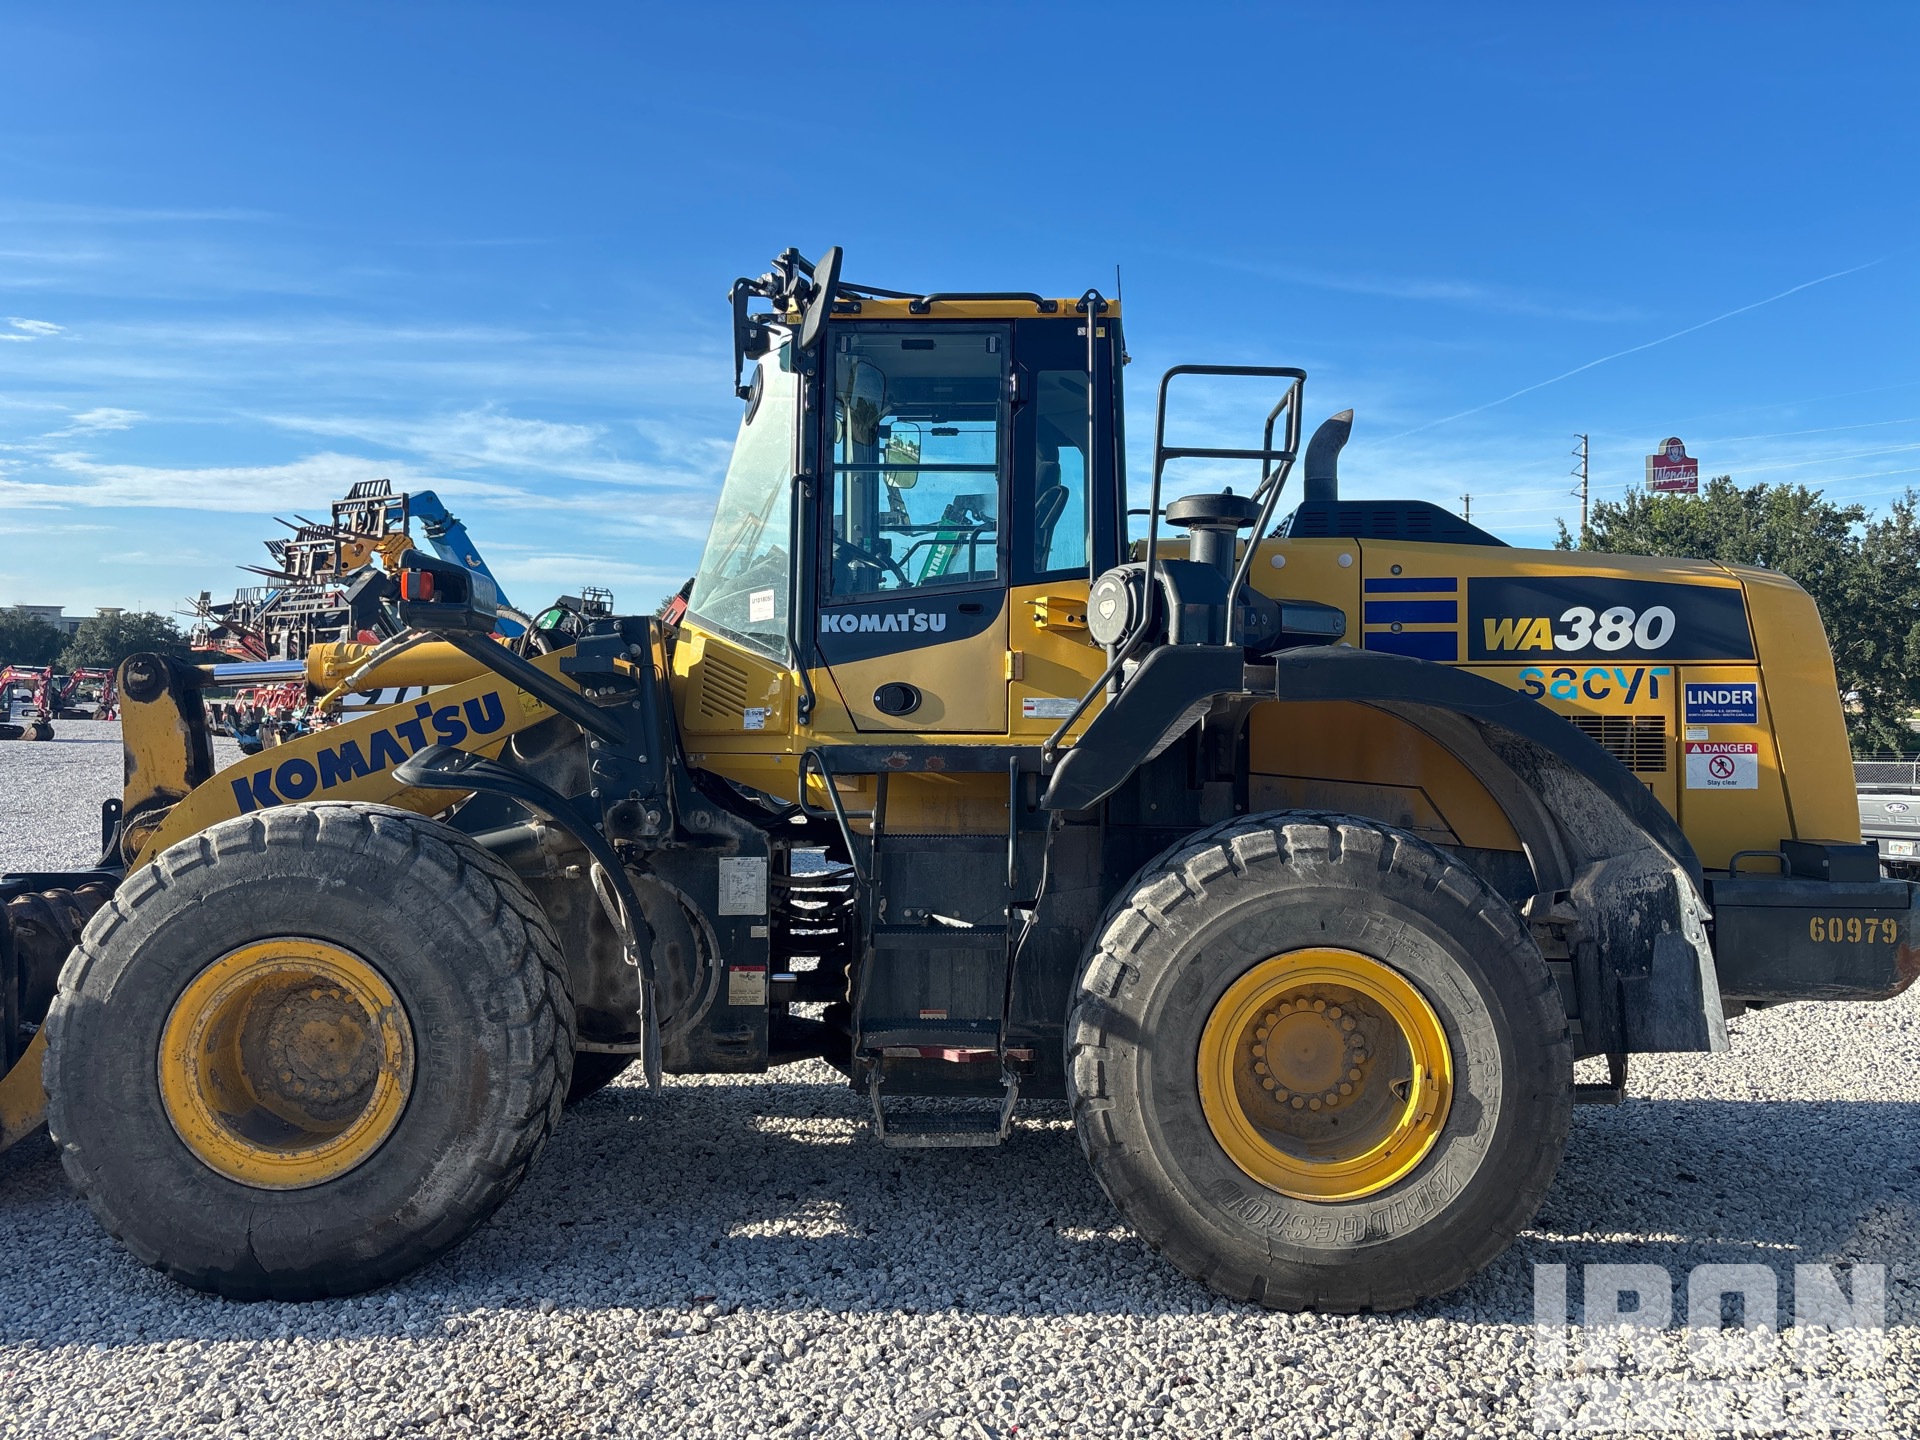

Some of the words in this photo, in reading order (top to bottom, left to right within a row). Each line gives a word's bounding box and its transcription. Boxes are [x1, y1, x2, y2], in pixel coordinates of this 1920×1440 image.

[1655, 464, 1696, 488] Wendy's
[821, 608, 946, 633] KOMATSU
[1483, 606, 1676, 651] WA380
[1518, 667, 1671, 704] sacyr
[1688, 690, 1754, 705] LINDER
[231, 691, 506, 816] KOMATSU
[1704, 744, 1753, 753] DANGER
[1809, 917, 1898, 944] 60979
